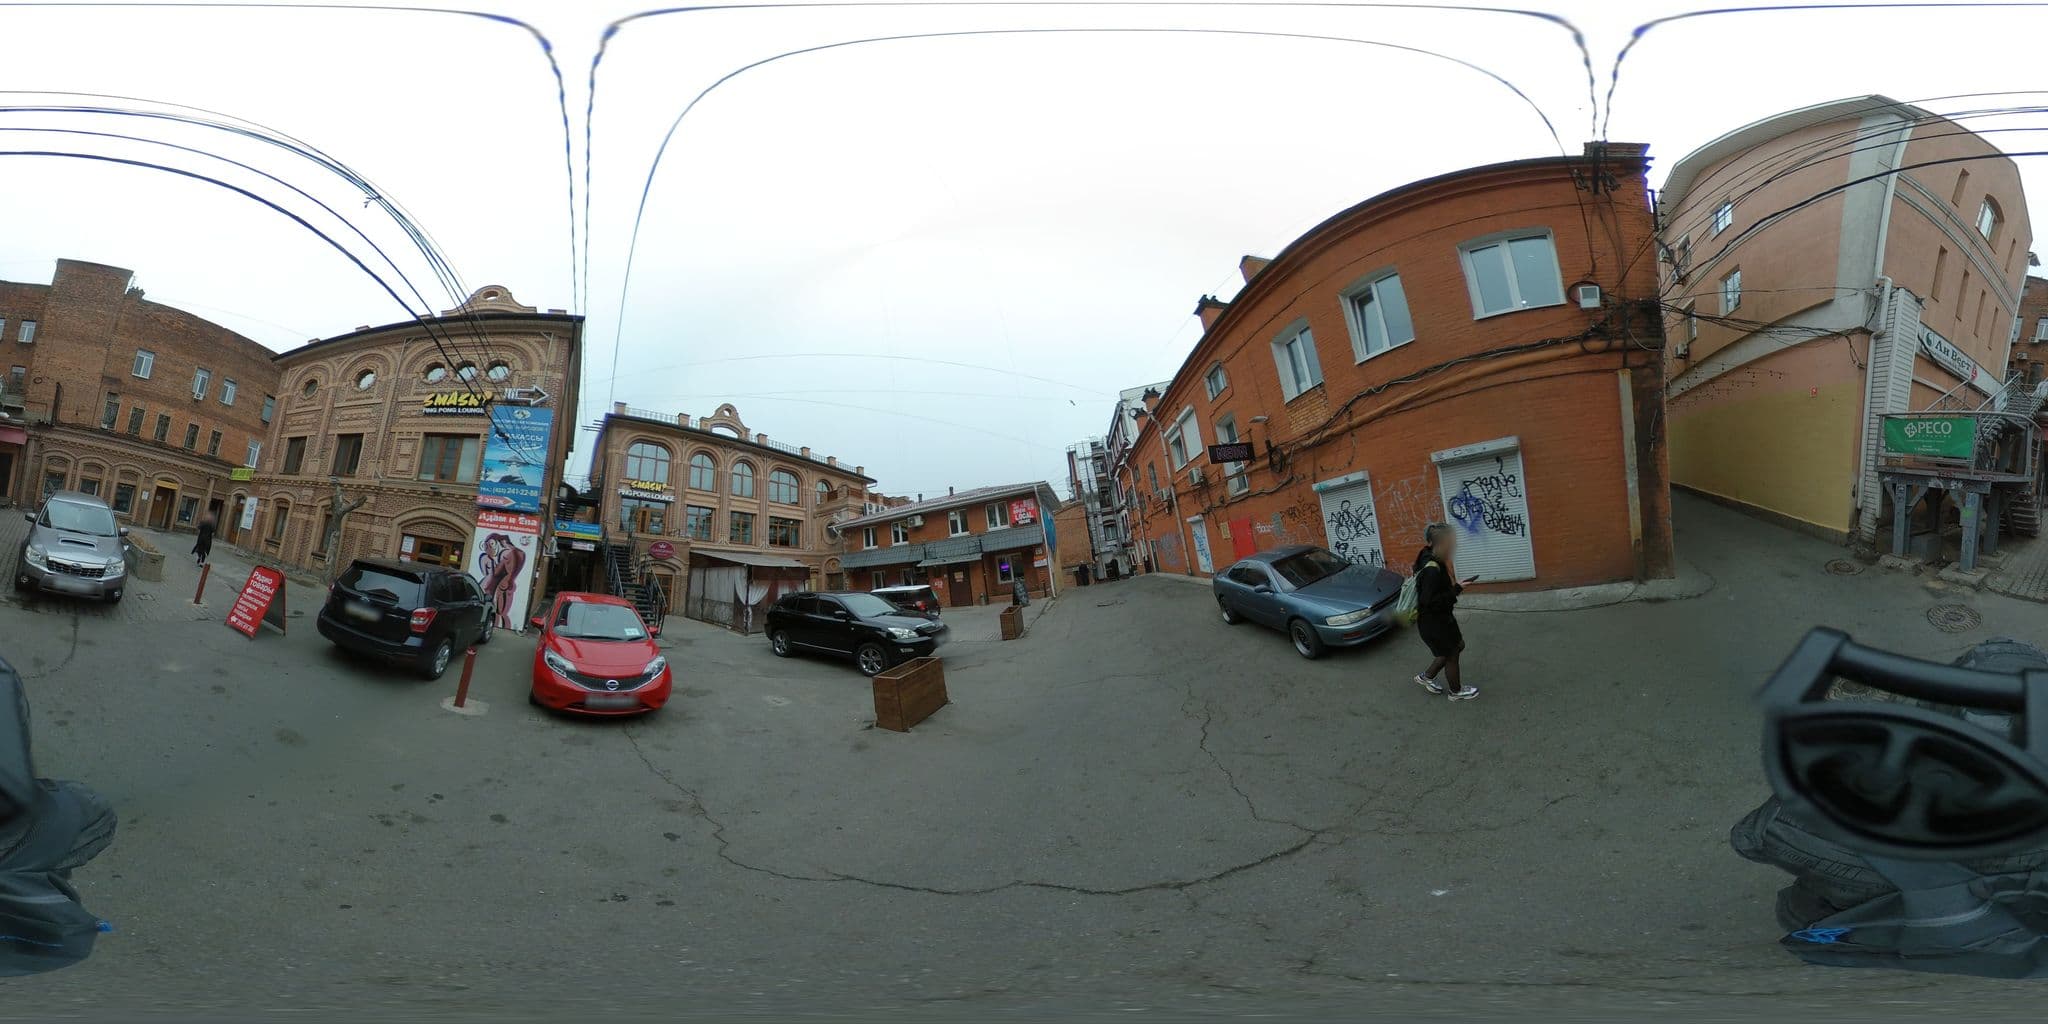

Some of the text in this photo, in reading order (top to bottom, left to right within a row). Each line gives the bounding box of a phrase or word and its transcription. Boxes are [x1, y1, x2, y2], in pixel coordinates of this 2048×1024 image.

[652, 493, 676, 502] LOUNGE
[252, 571, 273, 584] Радио
[250, 579, 275, 594] товары
